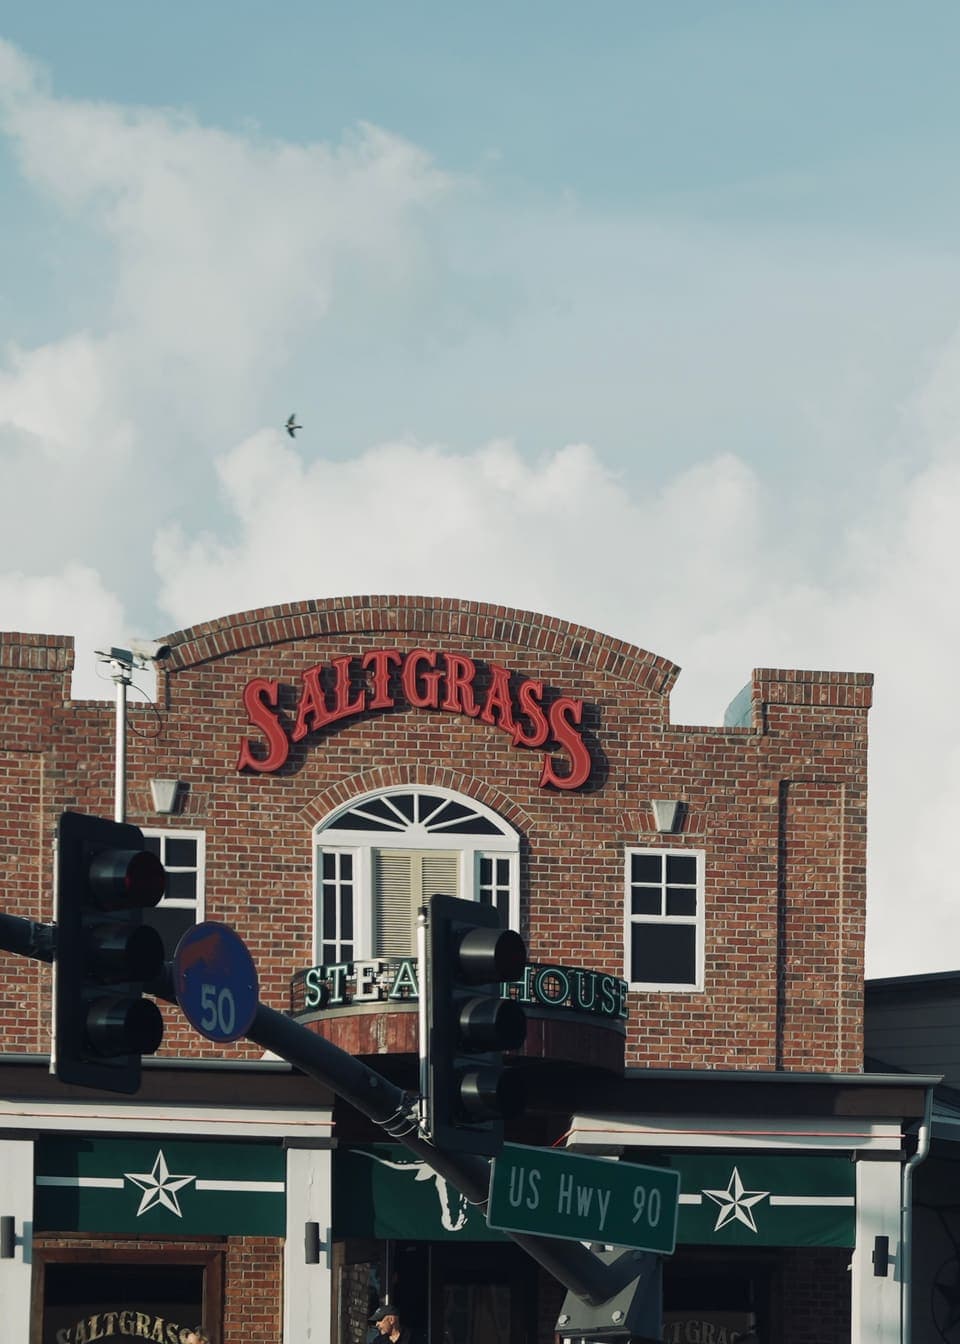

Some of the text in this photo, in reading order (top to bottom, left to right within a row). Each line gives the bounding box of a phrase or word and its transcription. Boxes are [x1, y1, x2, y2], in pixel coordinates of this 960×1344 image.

[236, 649, 592, 790] SALTGRASS
[201, 983, 236, 1034] 50
[304, 957, 421, 1009] STEA
[509, 1166, 661, 1231] US Hwy 90
